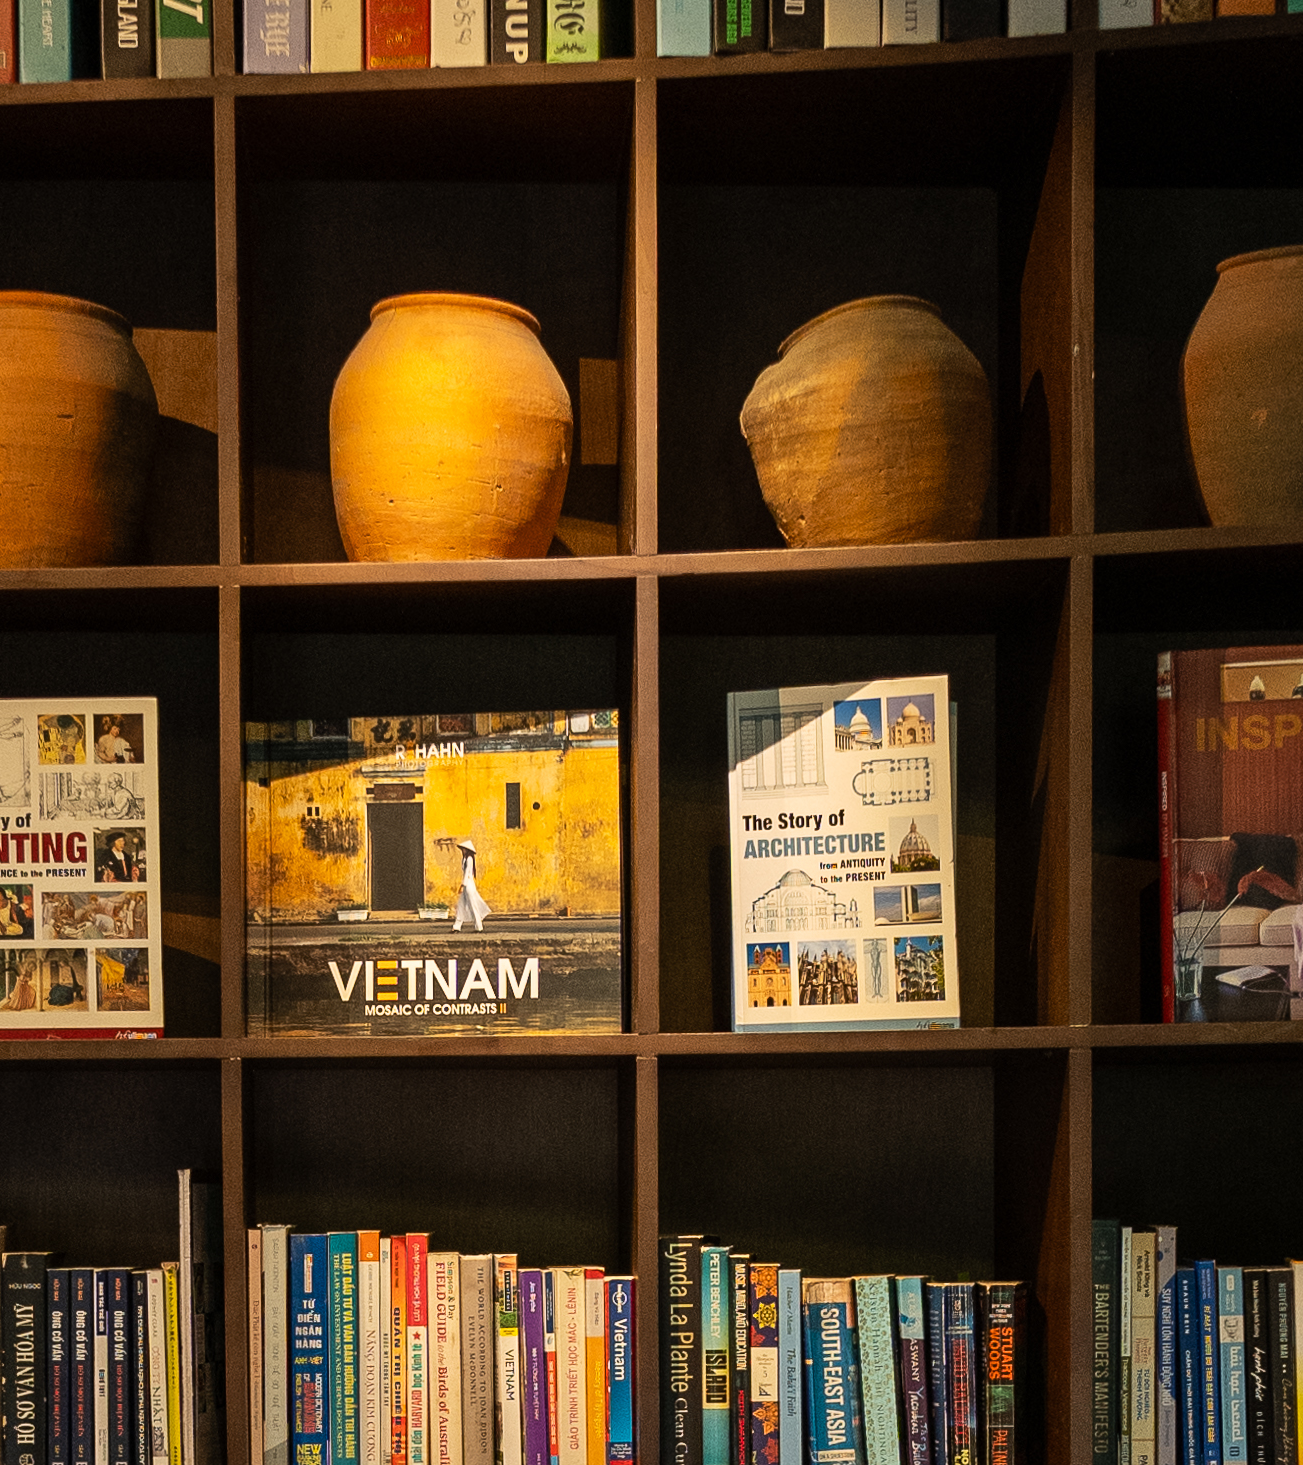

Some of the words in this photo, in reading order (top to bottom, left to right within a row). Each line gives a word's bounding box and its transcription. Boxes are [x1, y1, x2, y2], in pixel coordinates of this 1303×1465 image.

[16, 813, 33, 828] of
[742, 814, 773, 833] The
[777, 812, 823, 832] Story
[827, 809, 846, 827] of
[743, 832, 887, 860] ARCHITECTURE
[840, 858, 887, 870] ANTIQUITY
[20, 868, 29, 879] to
[30, 868, 44, 879] the
[45, 868, 88, 879] PRESENT
[819, 876, 830, 885] to
[845, 871, 887, 883] PRESENT
[328, 957, 540, 1003] VIETNAM
[364, 1003, 412, 1017] MOSAIC
[413, 1003, 432, 1017] OF
[432, 1003, 498, 1017] CONTRASTS
[436, 1261, 448, 1300] FIELD
[664, 1242, 694, 1298] Lynda
[709, 1253, 722, 1285] PETER
[436, 1303, 448, 1344] GUIDE
[445, 1304, 456, 1321] Day
[670, 1303, 694, 1326] La
[709, 1287, 722, 1338] BENCHLEY
[613, 1318, 629, 1381] Vietnam
[988, 1326, 1001, 1381] WOODS
[1001, 1326, 1014, 1381] STUART
[1093, 1292, 1111, 1379] BARTENDER'S
[505, 1349, 516, 1401] VIETNAM
[670, 1331, 695, 1393] Plante
[785, 1348, 797, 1365] The
[819, 1307, 844, 1406] SOUTH-EAST
[908, 1338, 921, 1383] ASWANY
[438, 1366, 450, 1398] Birds
[439, 1401, 450, 1414] of
[674, 1397, 689, 1438] Clean
[785, 1396, 797, 1417] Faith
[1093, 1381, 1111, 1454] MANIFESTO
[825, 1409, 847, 1446] ASIA
[960, 1449, 970, 1465] NO
